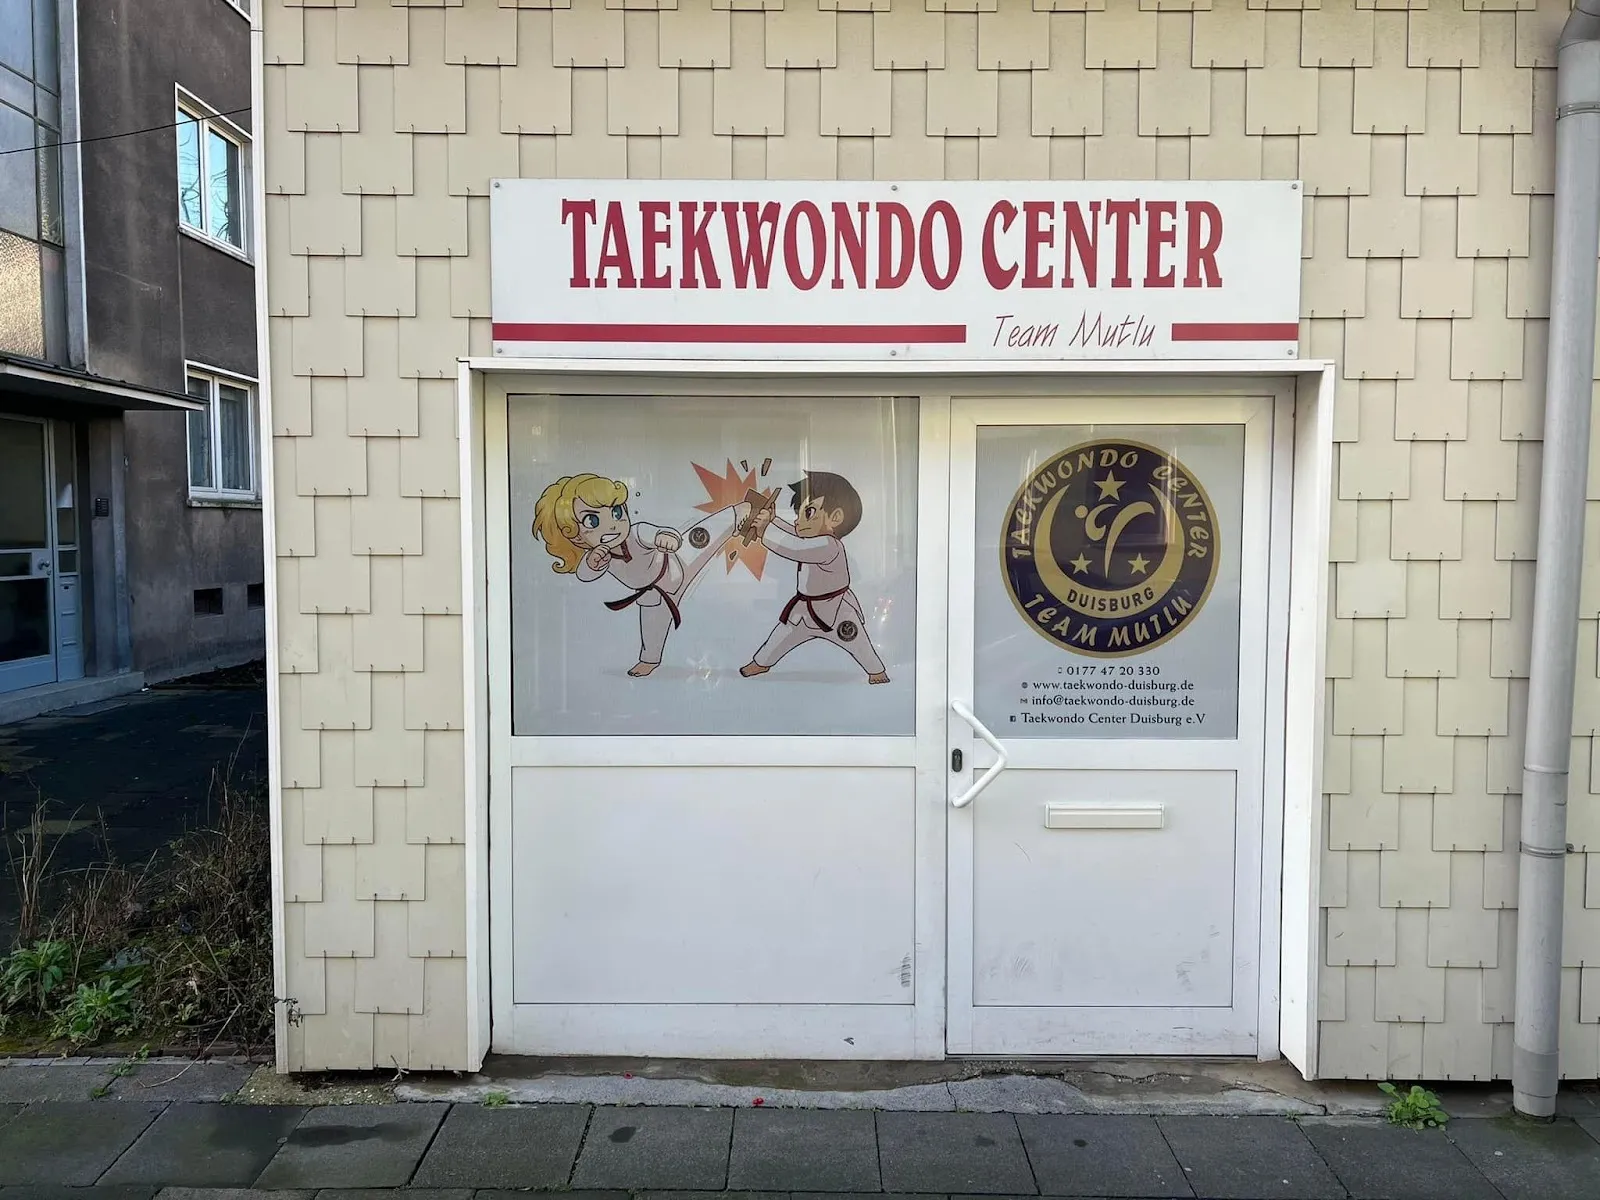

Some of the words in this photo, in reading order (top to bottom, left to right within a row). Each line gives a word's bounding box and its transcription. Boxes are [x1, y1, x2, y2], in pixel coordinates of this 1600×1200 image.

[561, 198, 962, 291] TAEKWONDO
[982, 198, 1223, 291] CENTER
[993, 314, 1059, 348] Team
[1068, 310, 1156, 348] Mutlu
[1067, 586, 1155, 612] DUISBURG
[1066, 666, 1097, 676] 0177
[1100, 666, 1116, 676] 47
[1119, 666, 1134, 676] 20
[1138, 666, 1160, 676] 330
[1033, 680, 1194, 691] www.taekwondo-duisburg.de
[1032, 695, 1195, 707] info@taekwondo-duisburg.de
[1021, 712, 1085, 724] Taekwondo
[1088, 712, 1127, 724] Center
[1130, 712, 1182, 726] Duisburg
[1186, 713, 1206, 724] e.V
